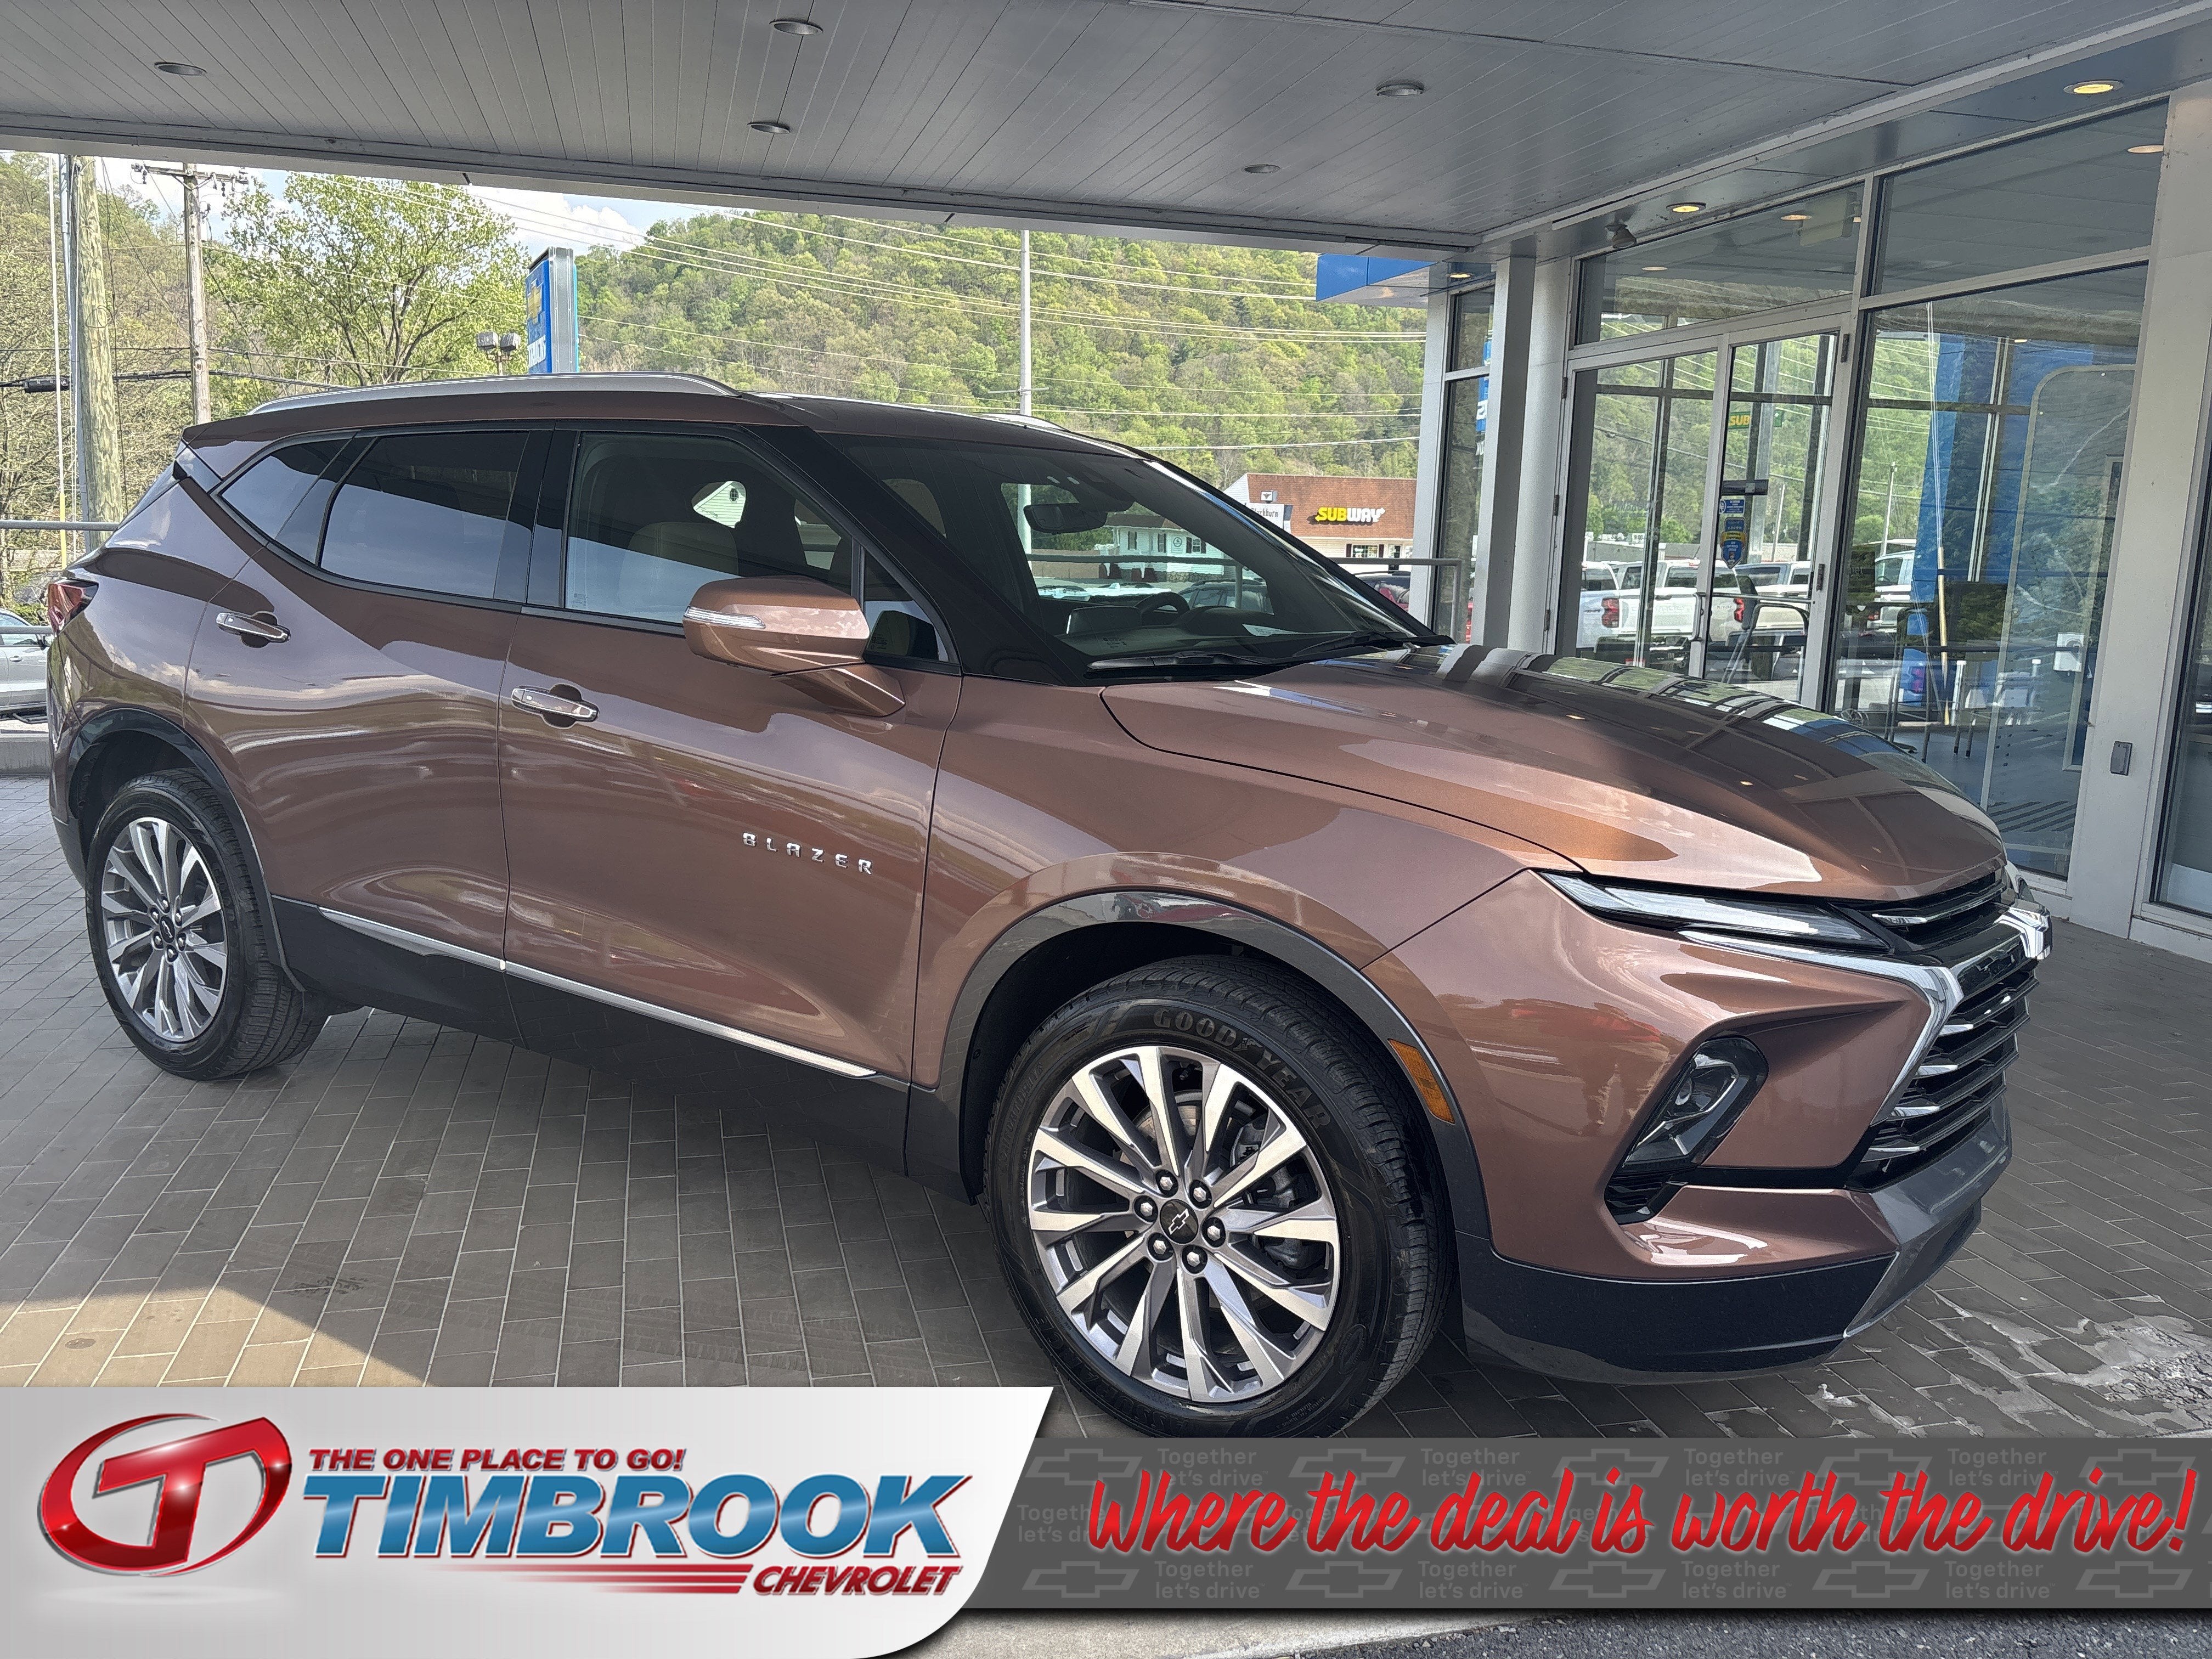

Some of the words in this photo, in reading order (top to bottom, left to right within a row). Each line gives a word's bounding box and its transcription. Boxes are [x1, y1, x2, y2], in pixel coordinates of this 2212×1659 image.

[1315, 507, 1385, 522] SUBWAY
[743, 832, 873, 875] BLAZER
[1153, 1008, 1331, 1128] GOODYEAR
